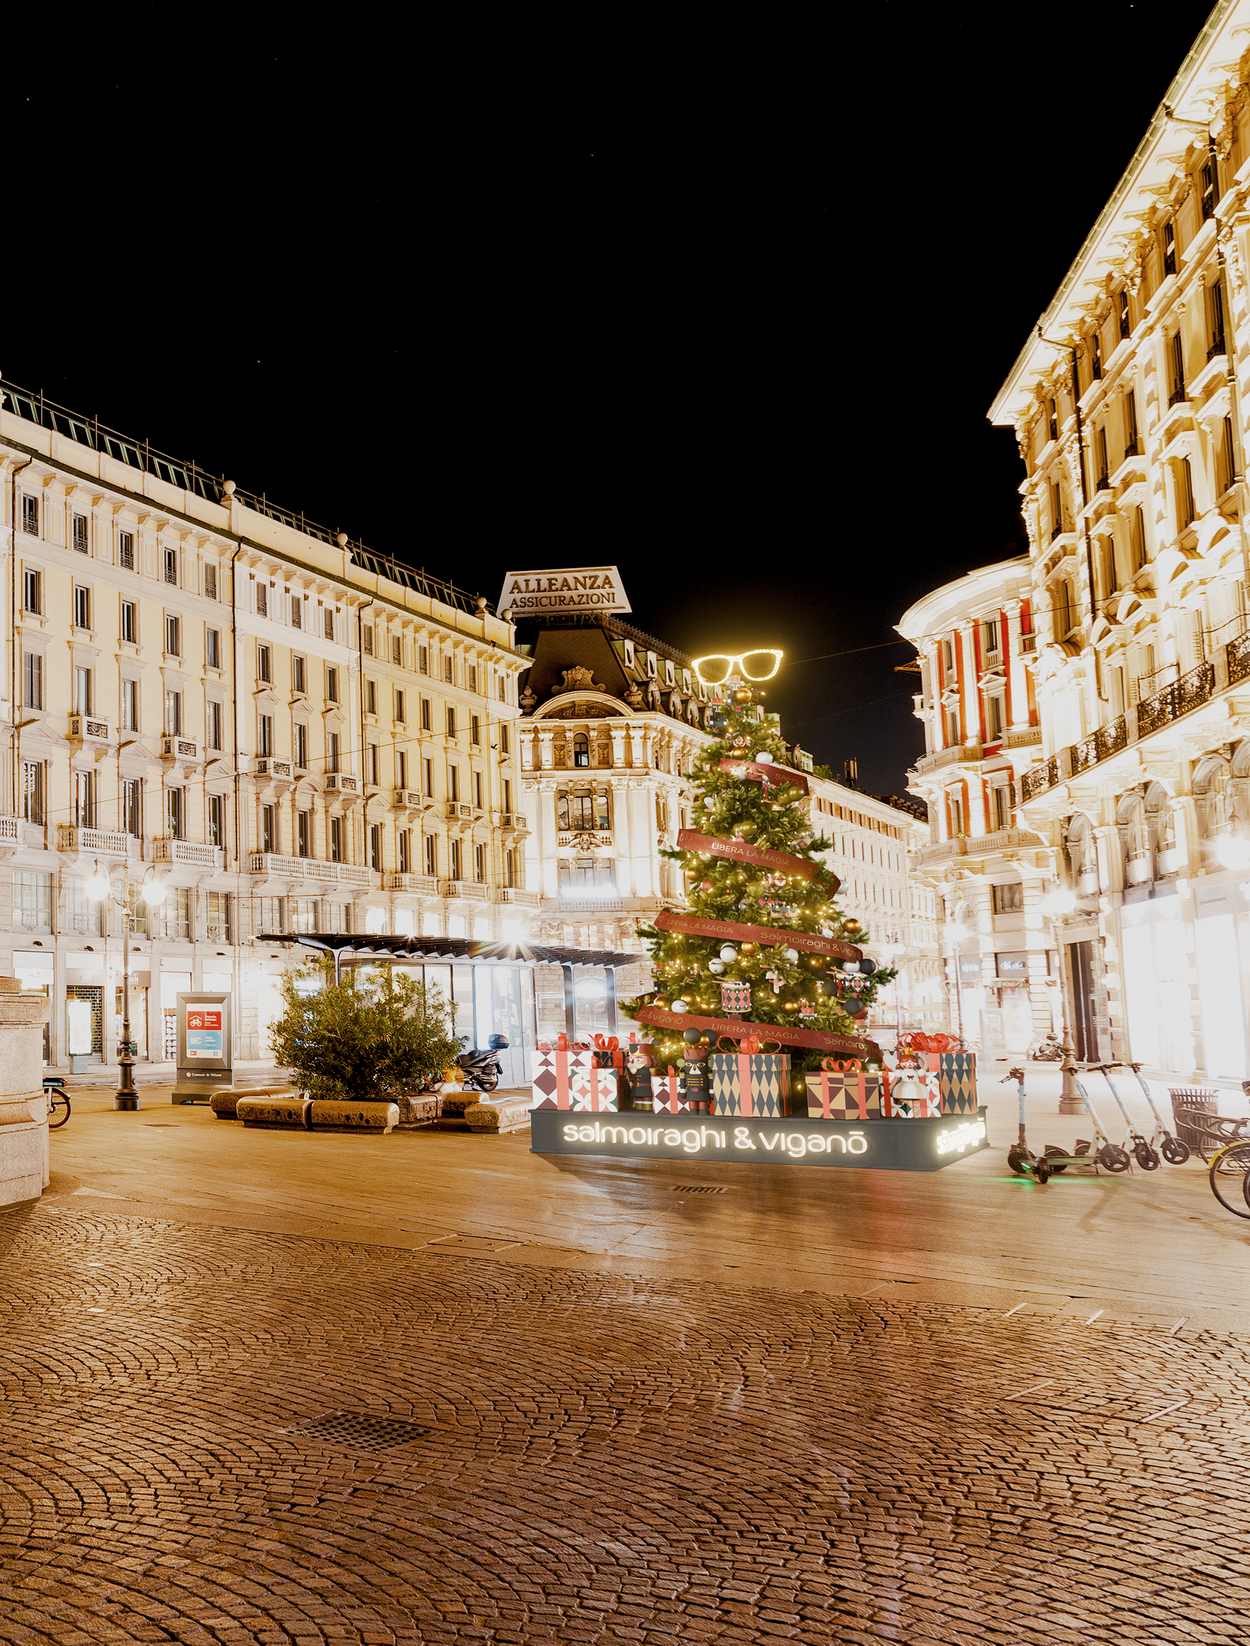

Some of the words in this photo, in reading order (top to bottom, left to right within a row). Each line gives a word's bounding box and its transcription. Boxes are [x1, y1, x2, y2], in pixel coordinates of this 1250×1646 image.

[509, 575, 615, 594] ALLEANZA
[509, 592, 616, 608] ASSICURAZIONI
[711, 842, 743, 855] LIBERA
[746, 850, 759, 859] LA
[760, 853, 790, 867] MAGIA
[667, 918, 688, 928] LIBERA
[701, 924, 734, 934] MAGIA
[832, 943, 840, 952] &
[190, 1037, 202, 1045] WC
[711, 1023, 747, 1035] LIBERA
[749, 1028, 763, 1037] LA
[765, 1029, 800, 1040] MAGIA
[733, 1127, 756, 1150] &
